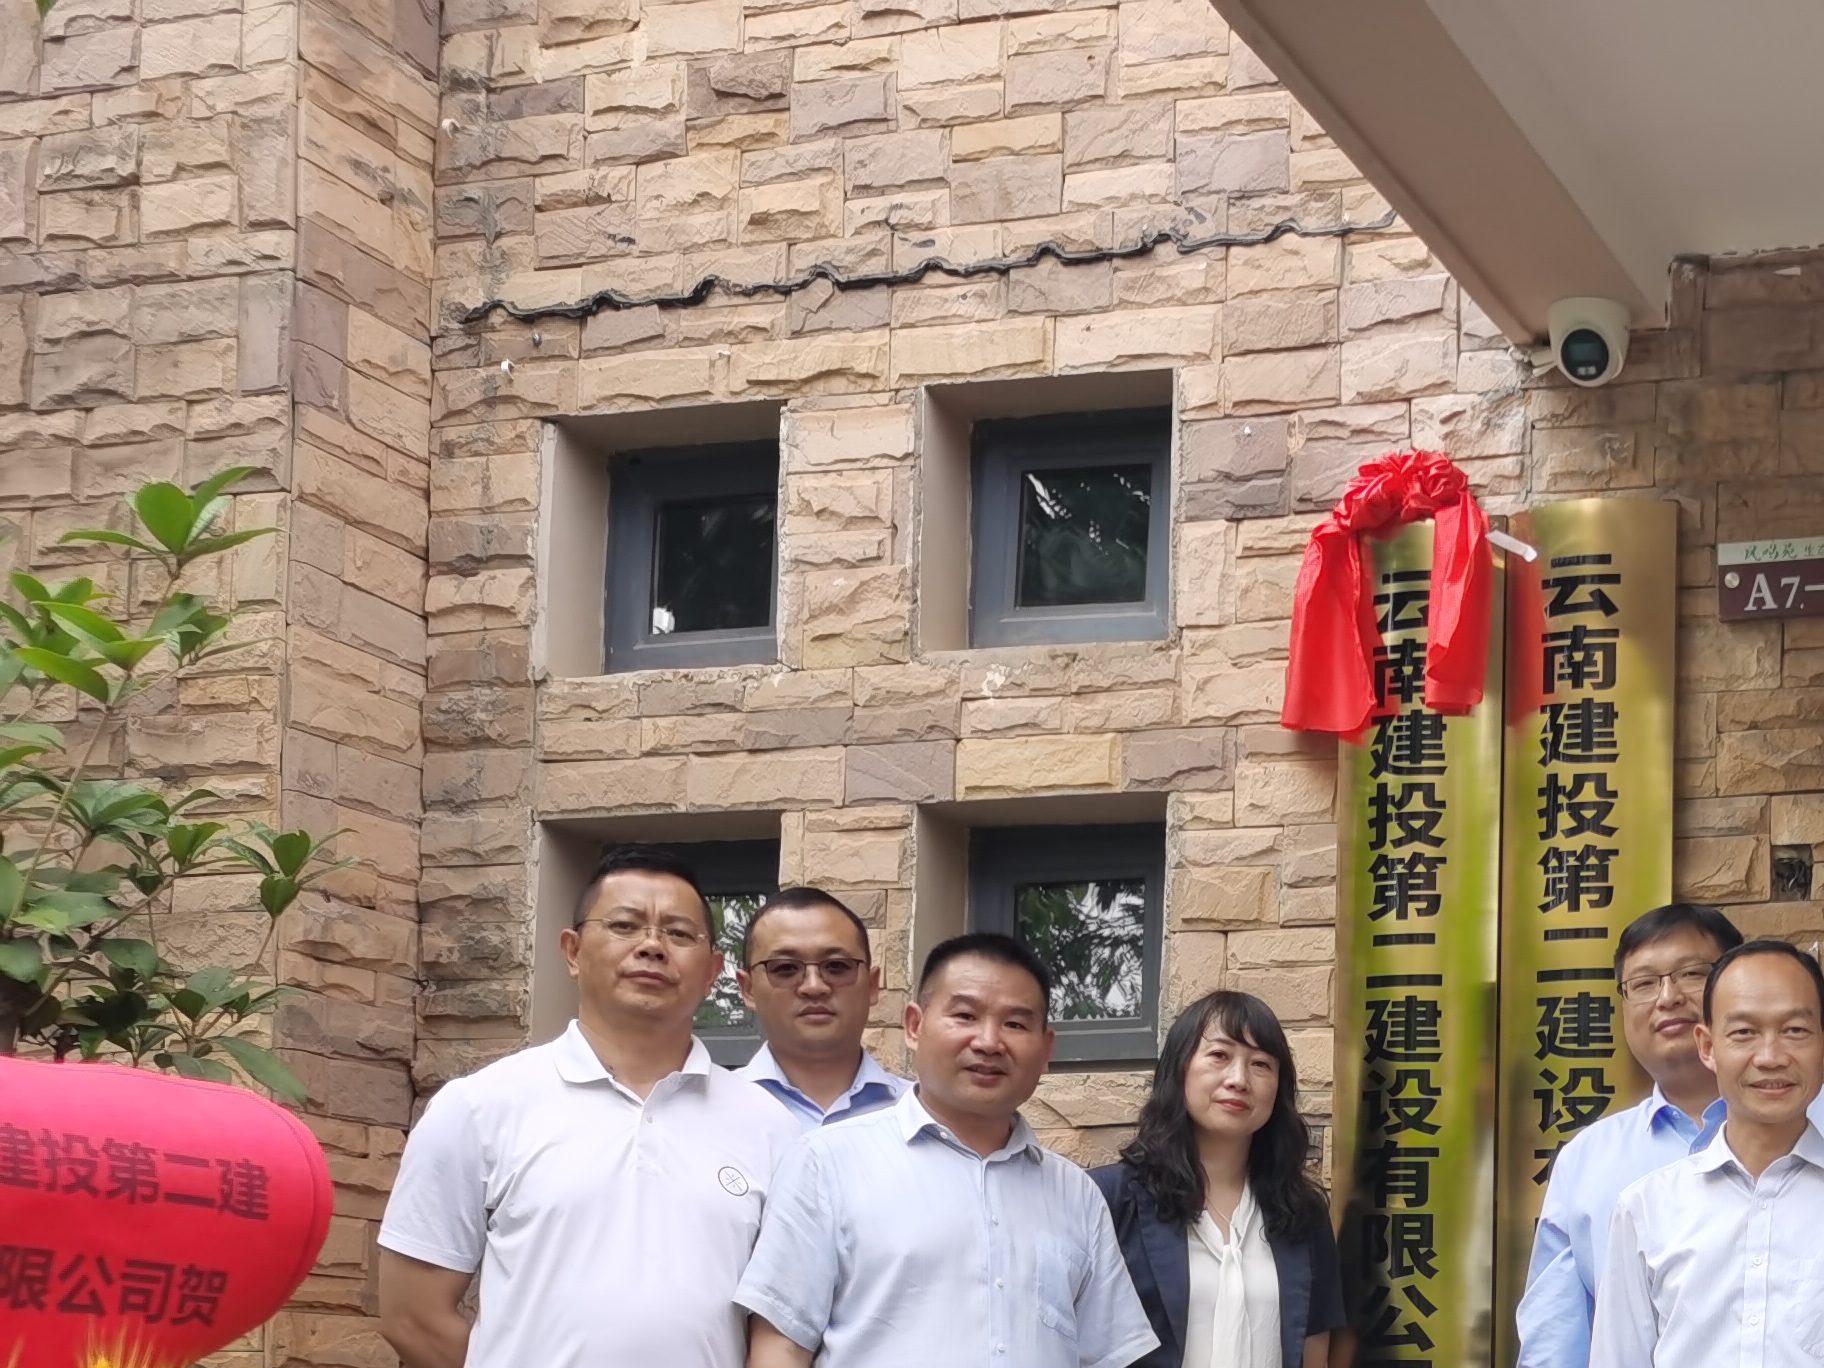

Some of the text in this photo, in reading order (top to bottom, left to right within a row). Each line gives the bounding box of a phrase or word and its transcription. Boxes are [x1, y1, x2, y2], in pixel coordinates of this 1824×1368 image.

[0, 1122, 270, 1221] 建投第二建
[0, 1243, 228, 1327] 限公司贺
